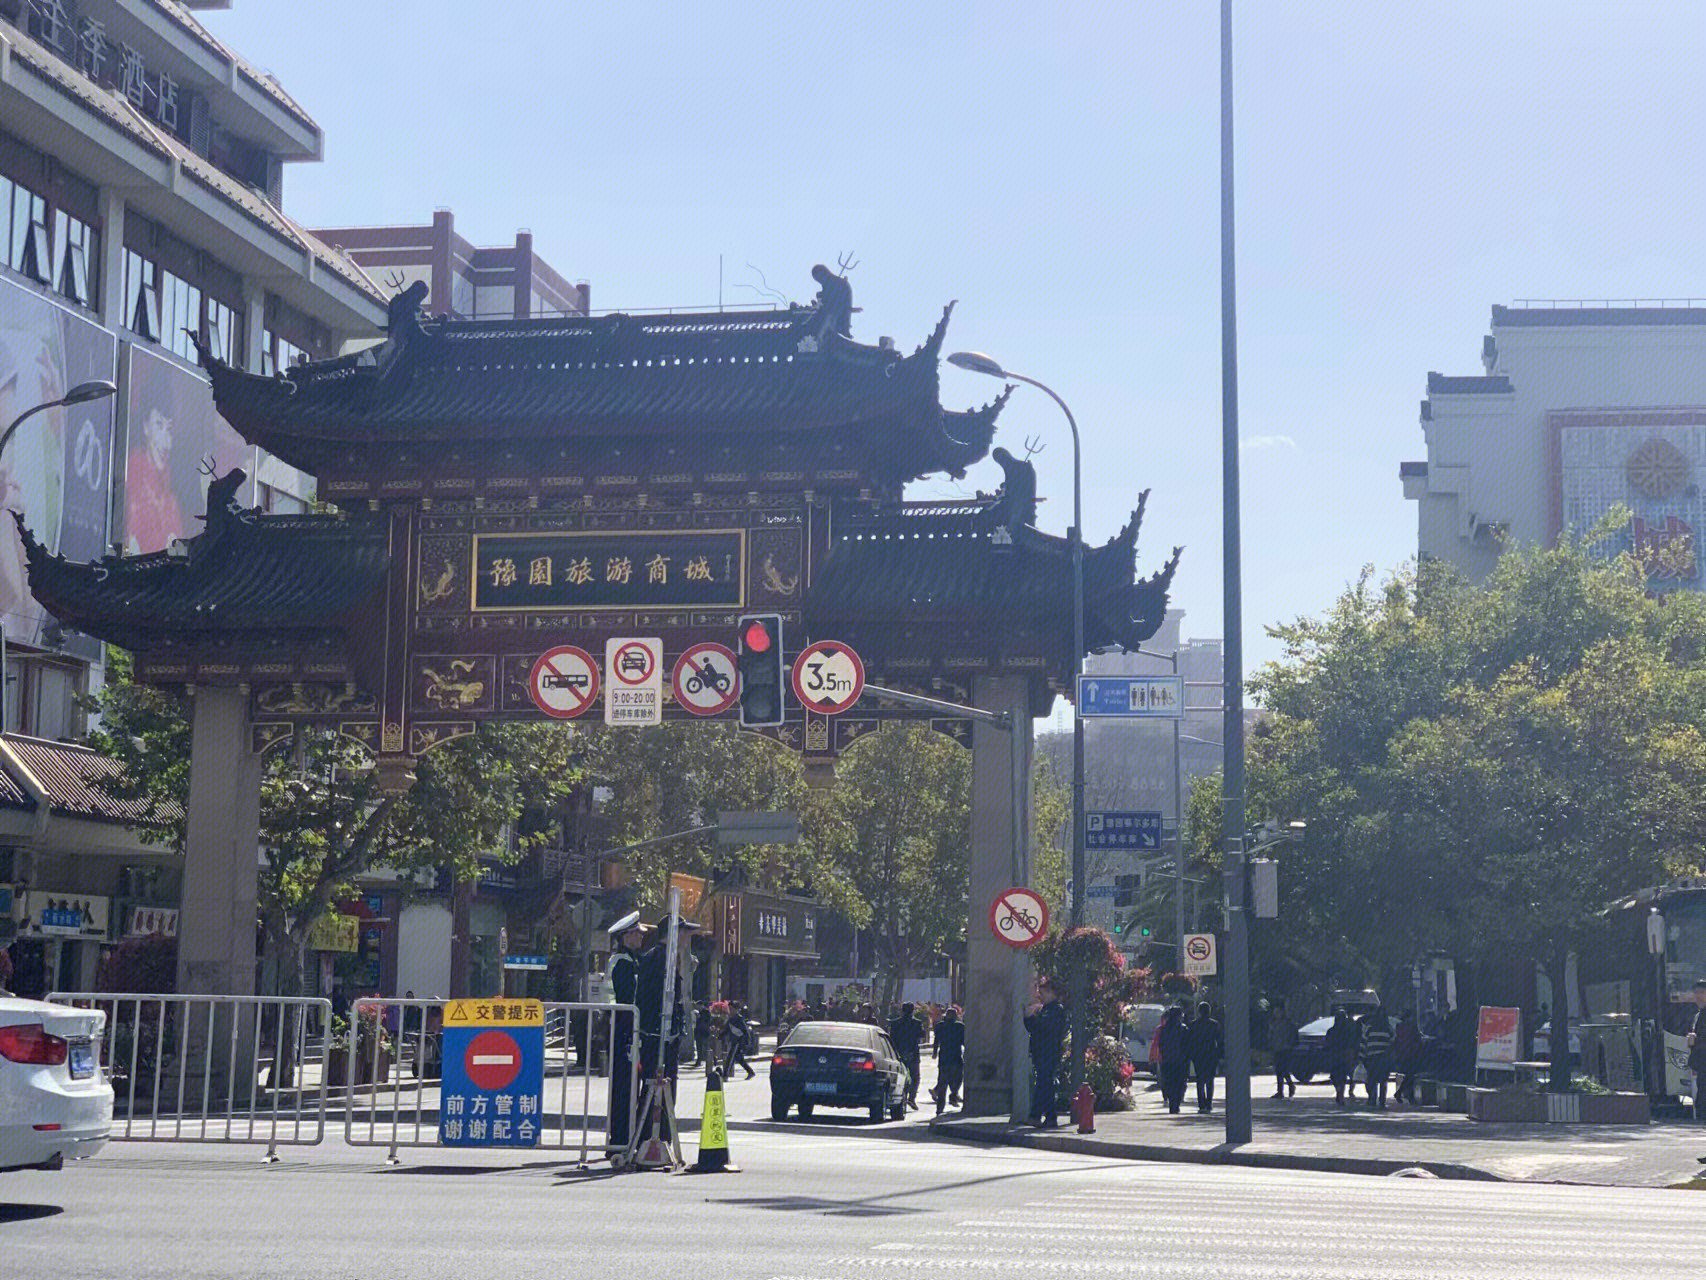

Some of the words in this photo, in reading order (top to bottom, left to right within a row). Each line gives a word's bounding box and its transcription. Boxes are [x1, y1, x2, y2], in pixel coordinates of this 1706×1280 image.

[808, 663, 851, 691] 3.5m
[476, 1005, 539, 1020] 交警提示
[447, 1094, 538, 1115] 前方管制
[444, 1118, 536, 1140] 谢谢配合
